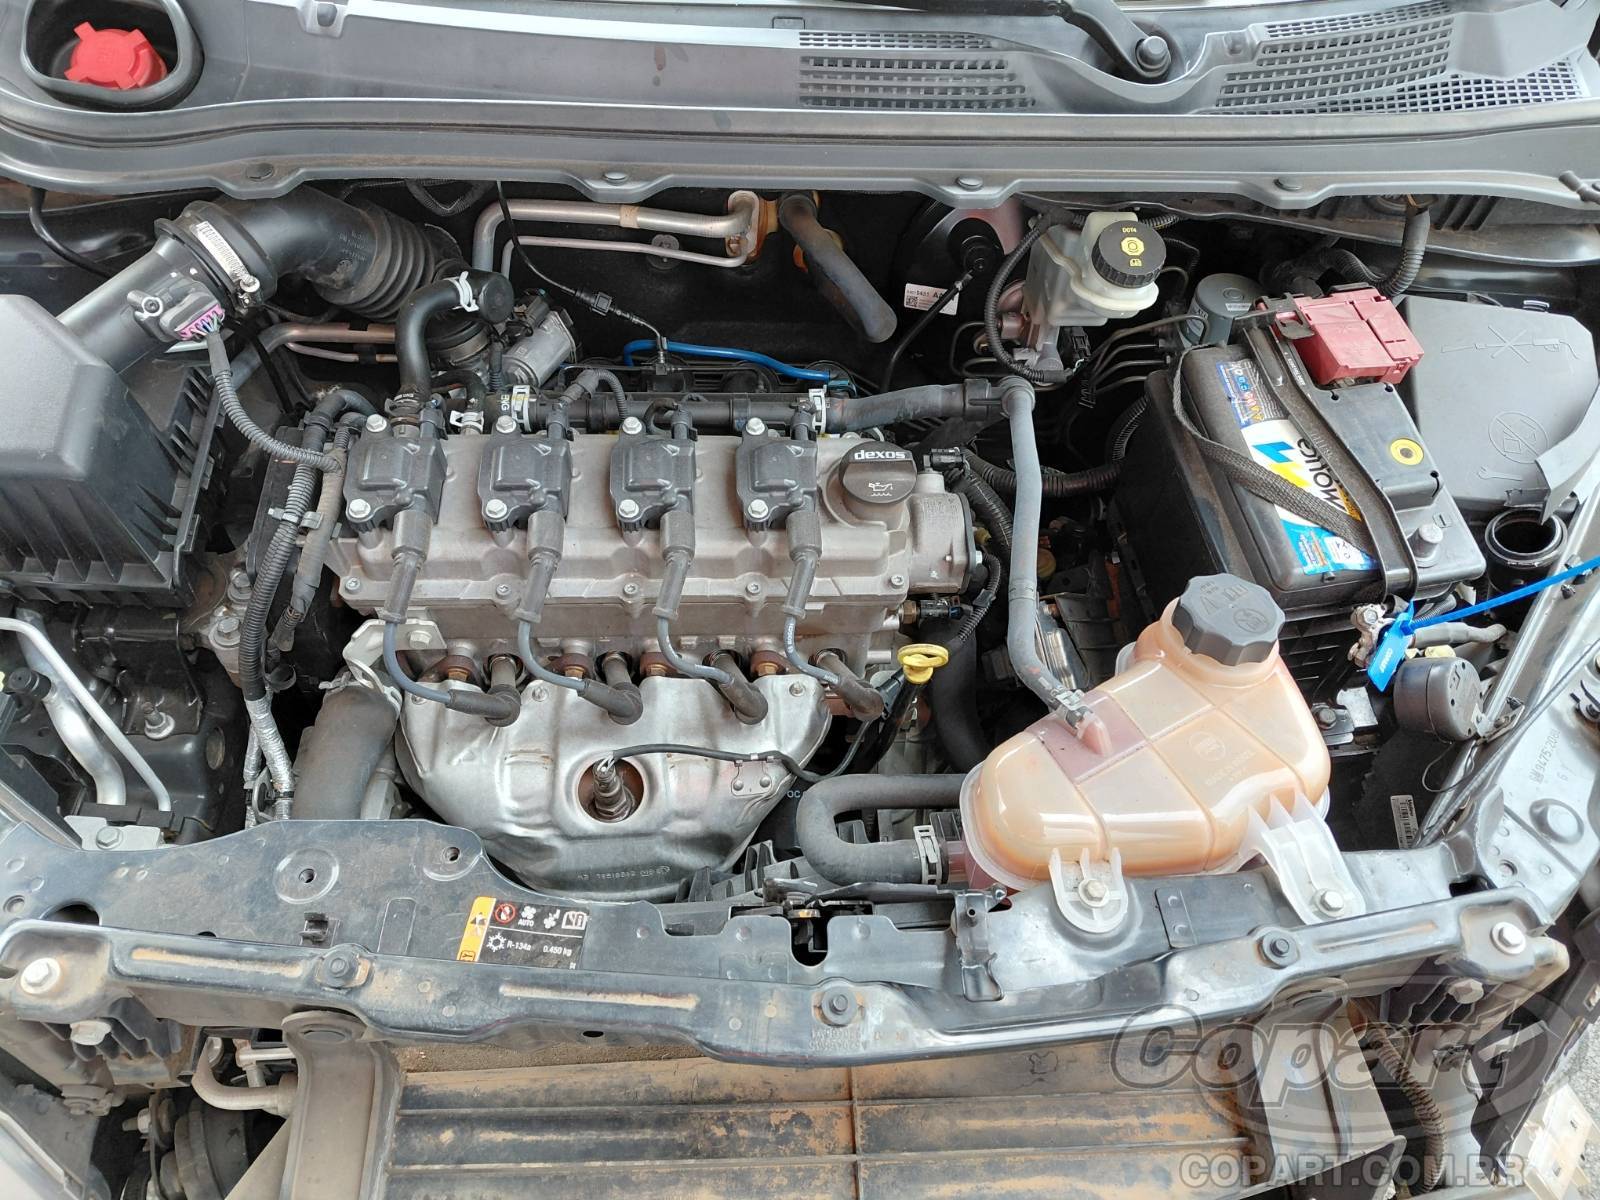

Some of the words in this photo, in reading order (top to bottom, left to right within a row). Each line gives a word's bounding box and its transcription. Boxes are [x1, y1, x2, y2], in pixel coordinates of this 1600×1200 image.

[500, 394, 510, 411] ENG
[854, 449, 906, 460] dexos
[518, 919, 535, 927] AUTO
[506, 940, 532, 951] R-134a
[543, 945, 562, 955] 0.450
[562, 948, 573, 957] kg
